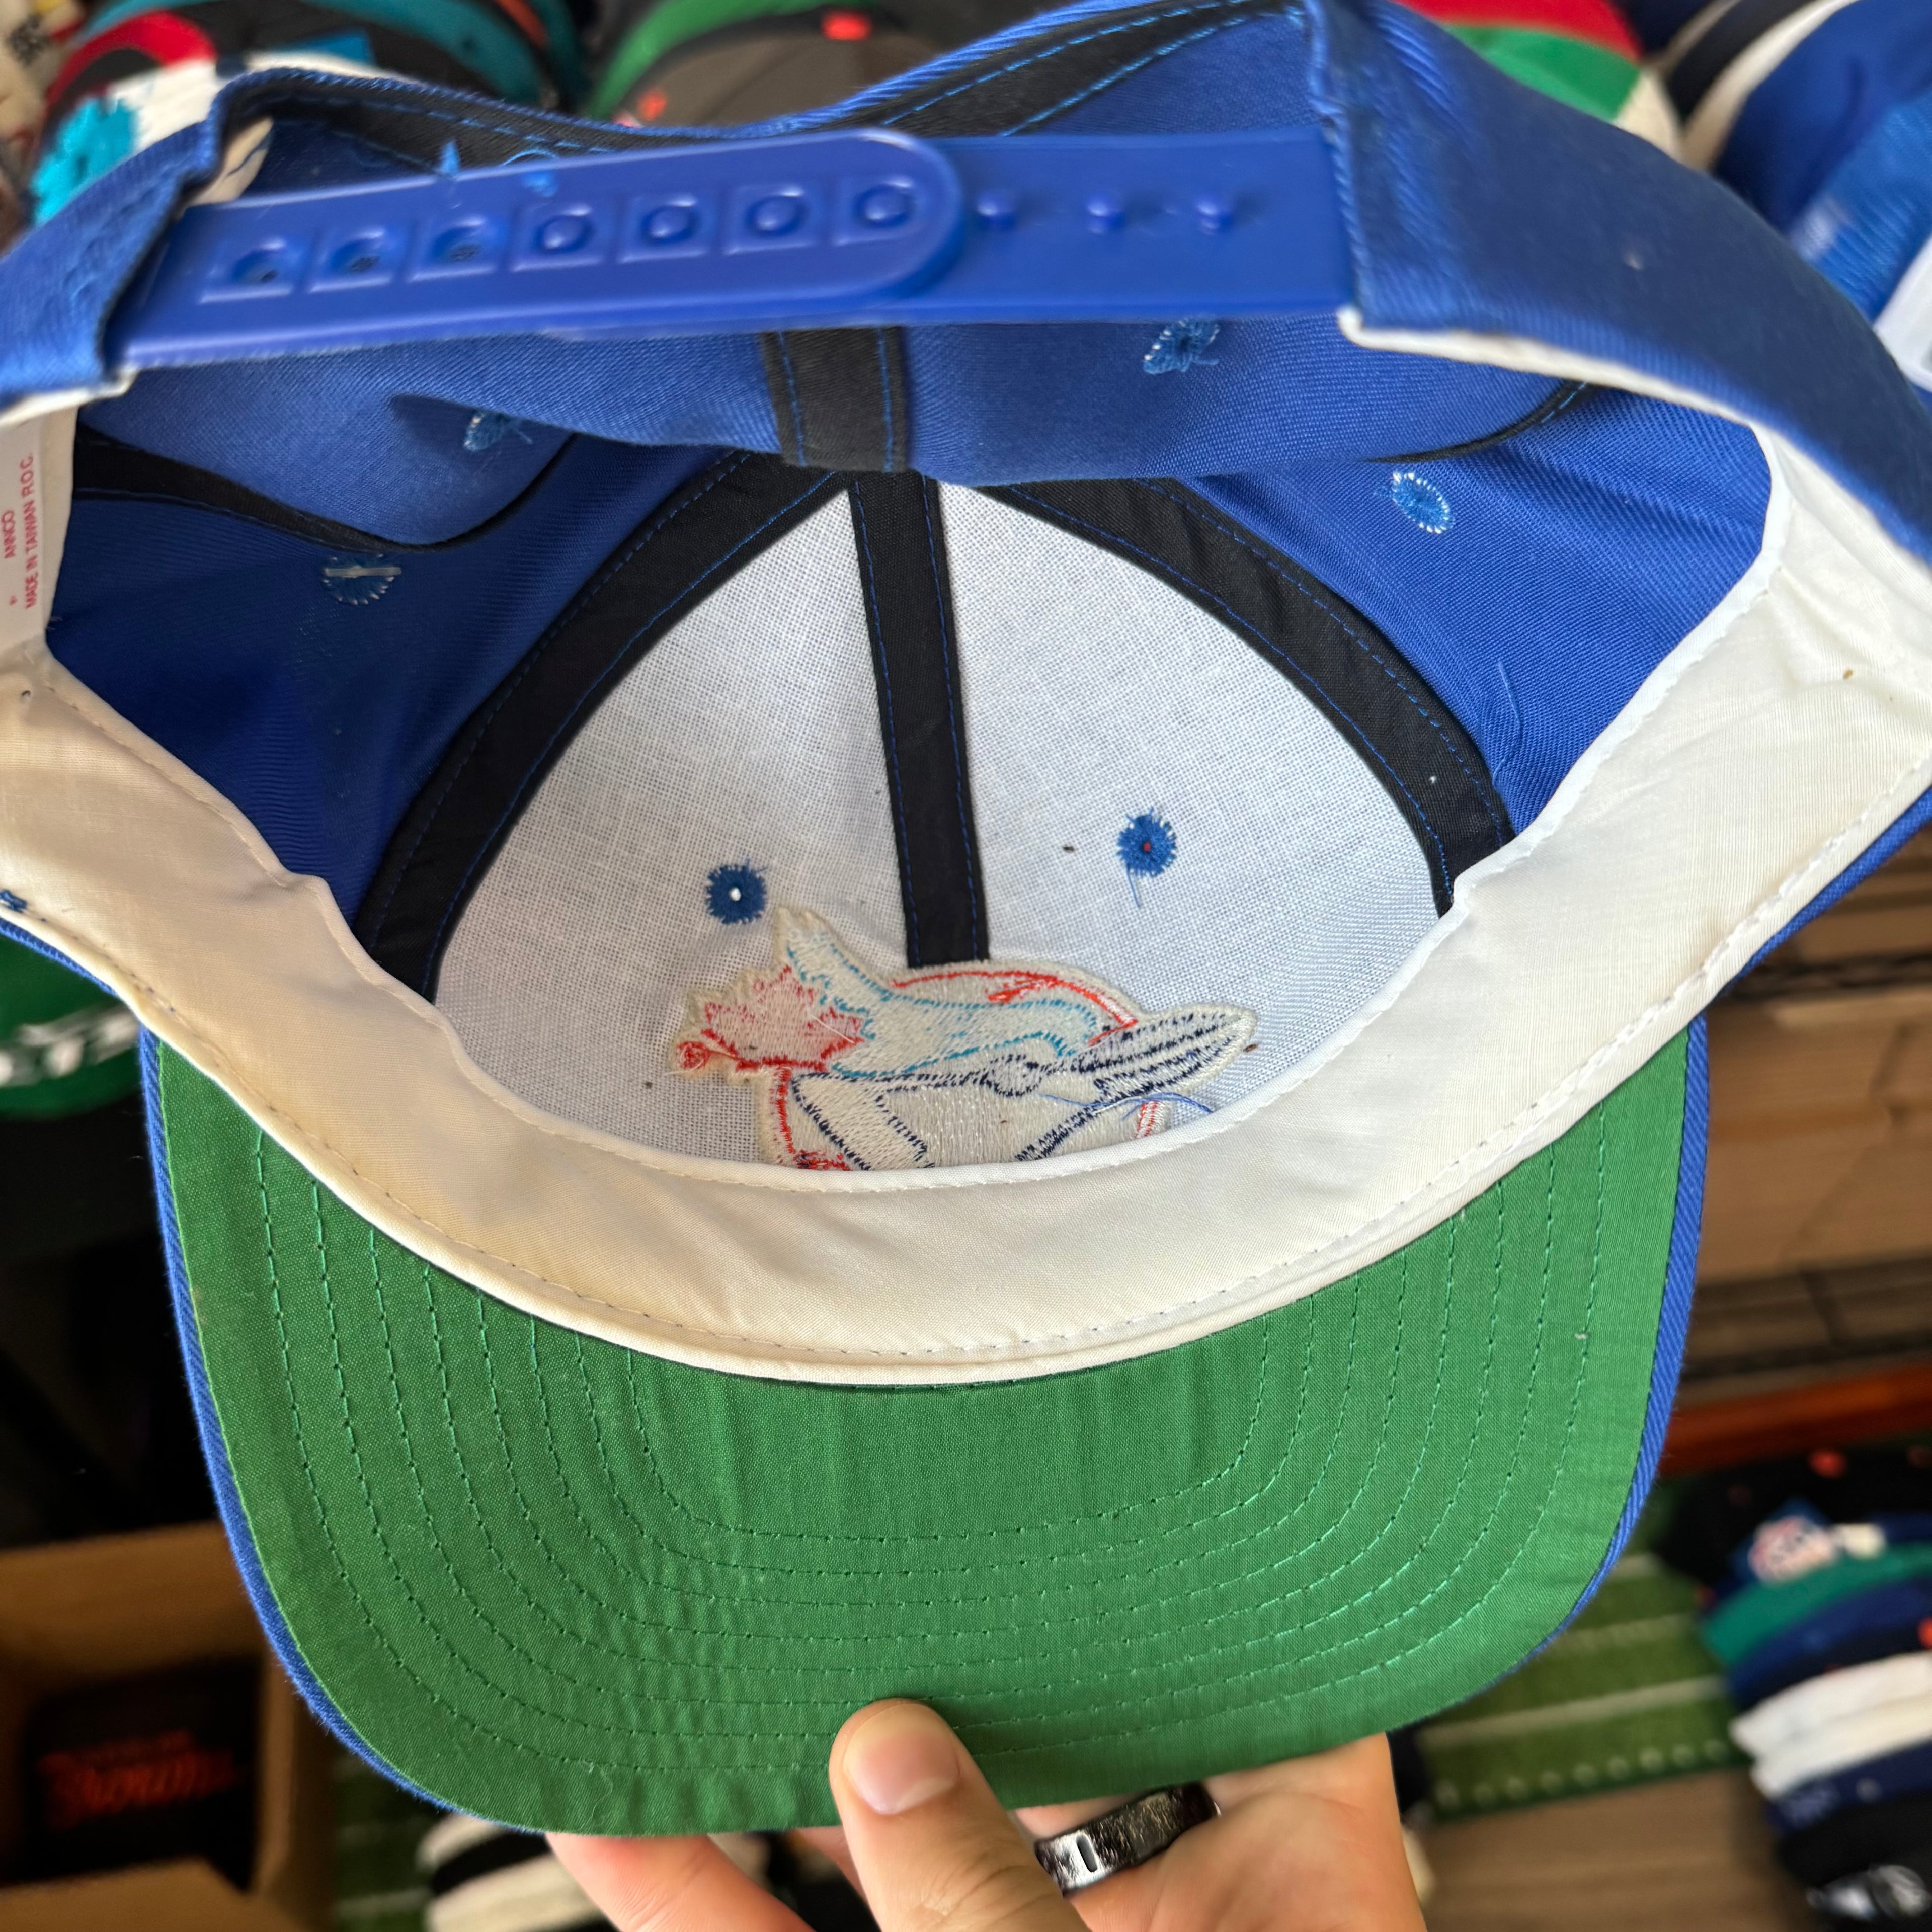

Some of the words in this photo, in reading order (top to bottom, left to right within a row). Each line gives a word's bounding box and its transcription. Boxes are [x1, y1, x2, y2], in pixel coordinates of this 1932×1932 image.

[24, 500, 37, 554] TAIWAN
[26, 555, 38, 570] IN
[25, 572, 38, 609] MADE
